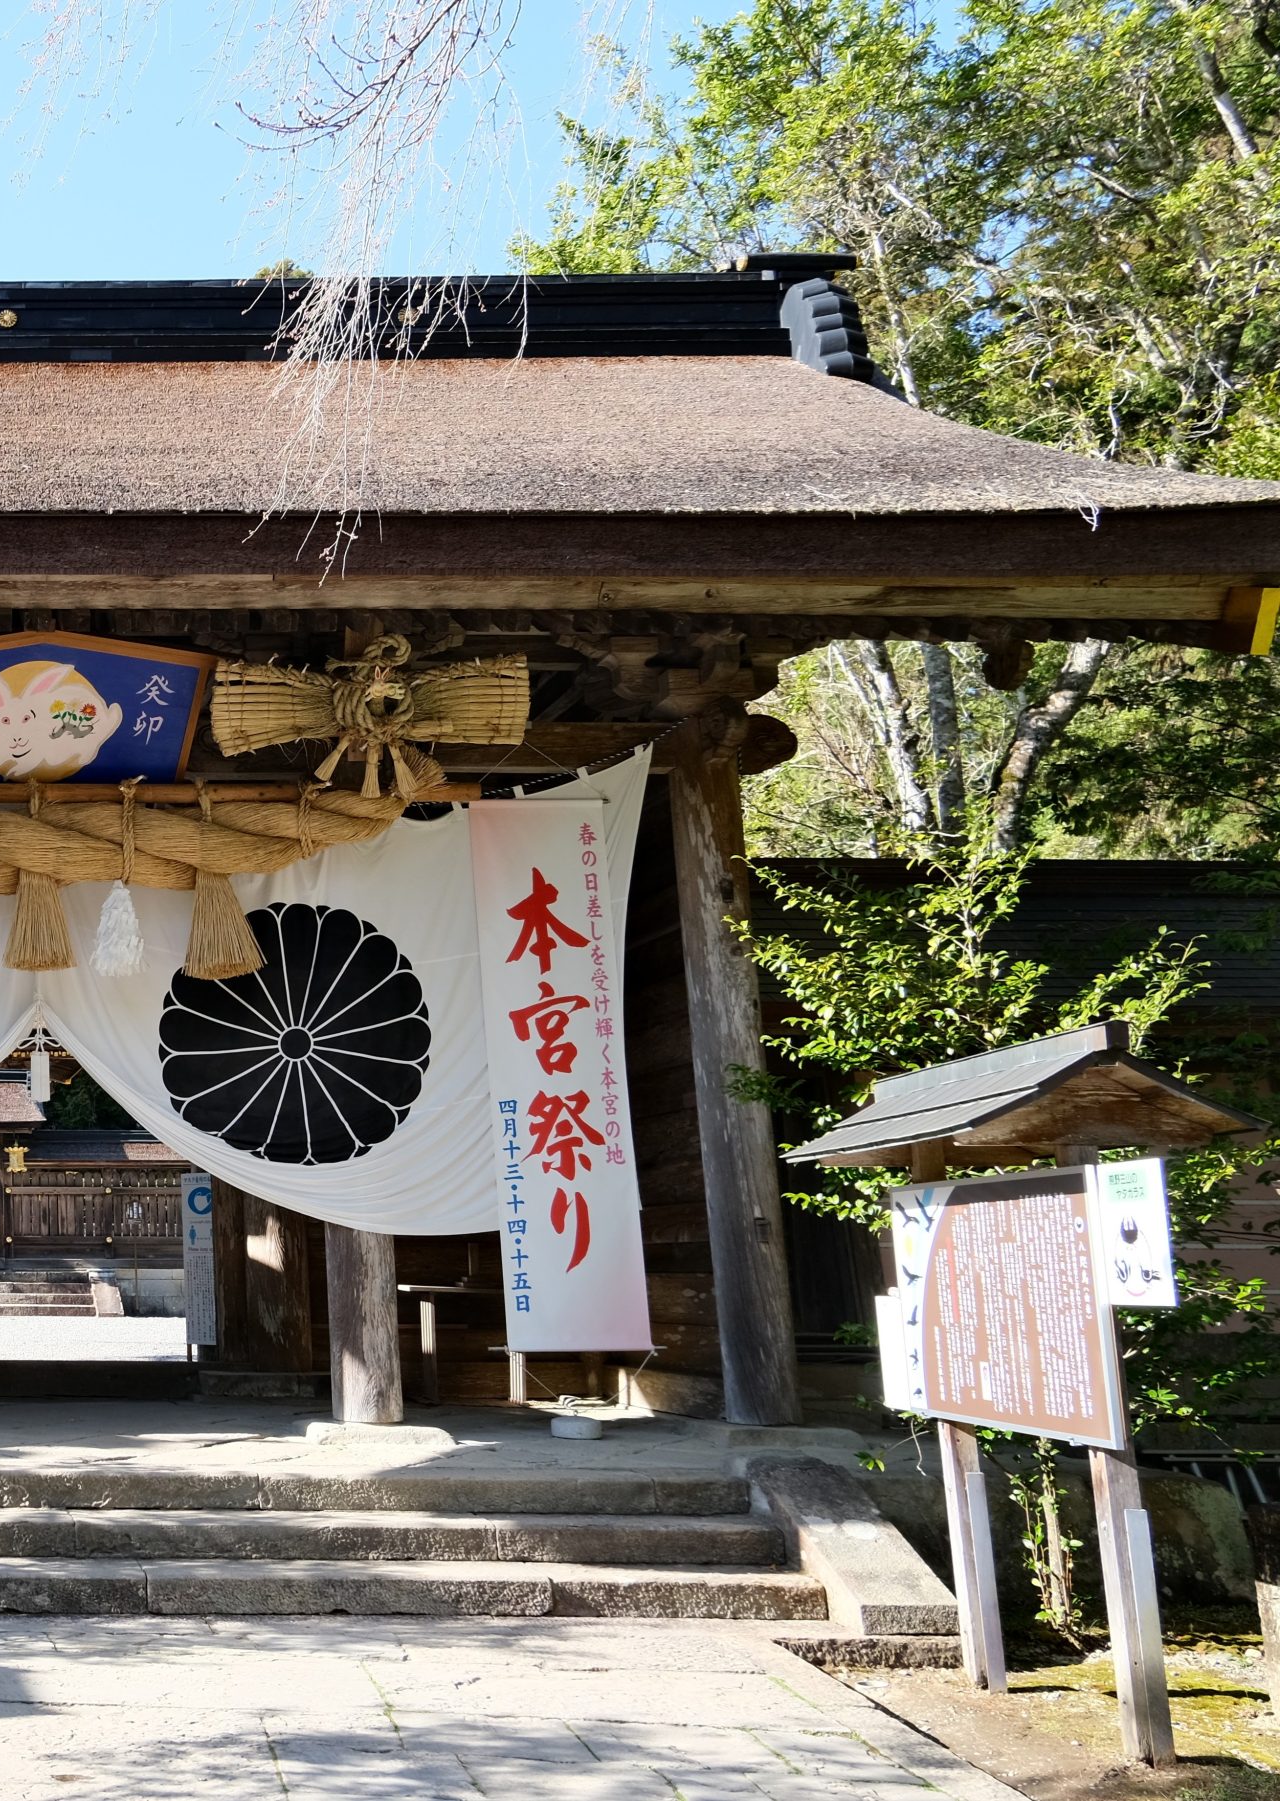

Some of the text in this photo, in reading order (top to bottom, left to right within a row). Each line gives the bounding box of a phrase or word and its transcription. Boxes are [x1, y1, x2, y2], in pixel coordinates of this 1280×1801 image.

[133, 674, 176, 745] 癸卯
[505, 867, 606, 1274] 本宮祭り
[577, 822, 627, 1166] 春の日差しを受け輝く本宮の地
[498, 1099, 532, 1313] 四月十三・十四・十五日
